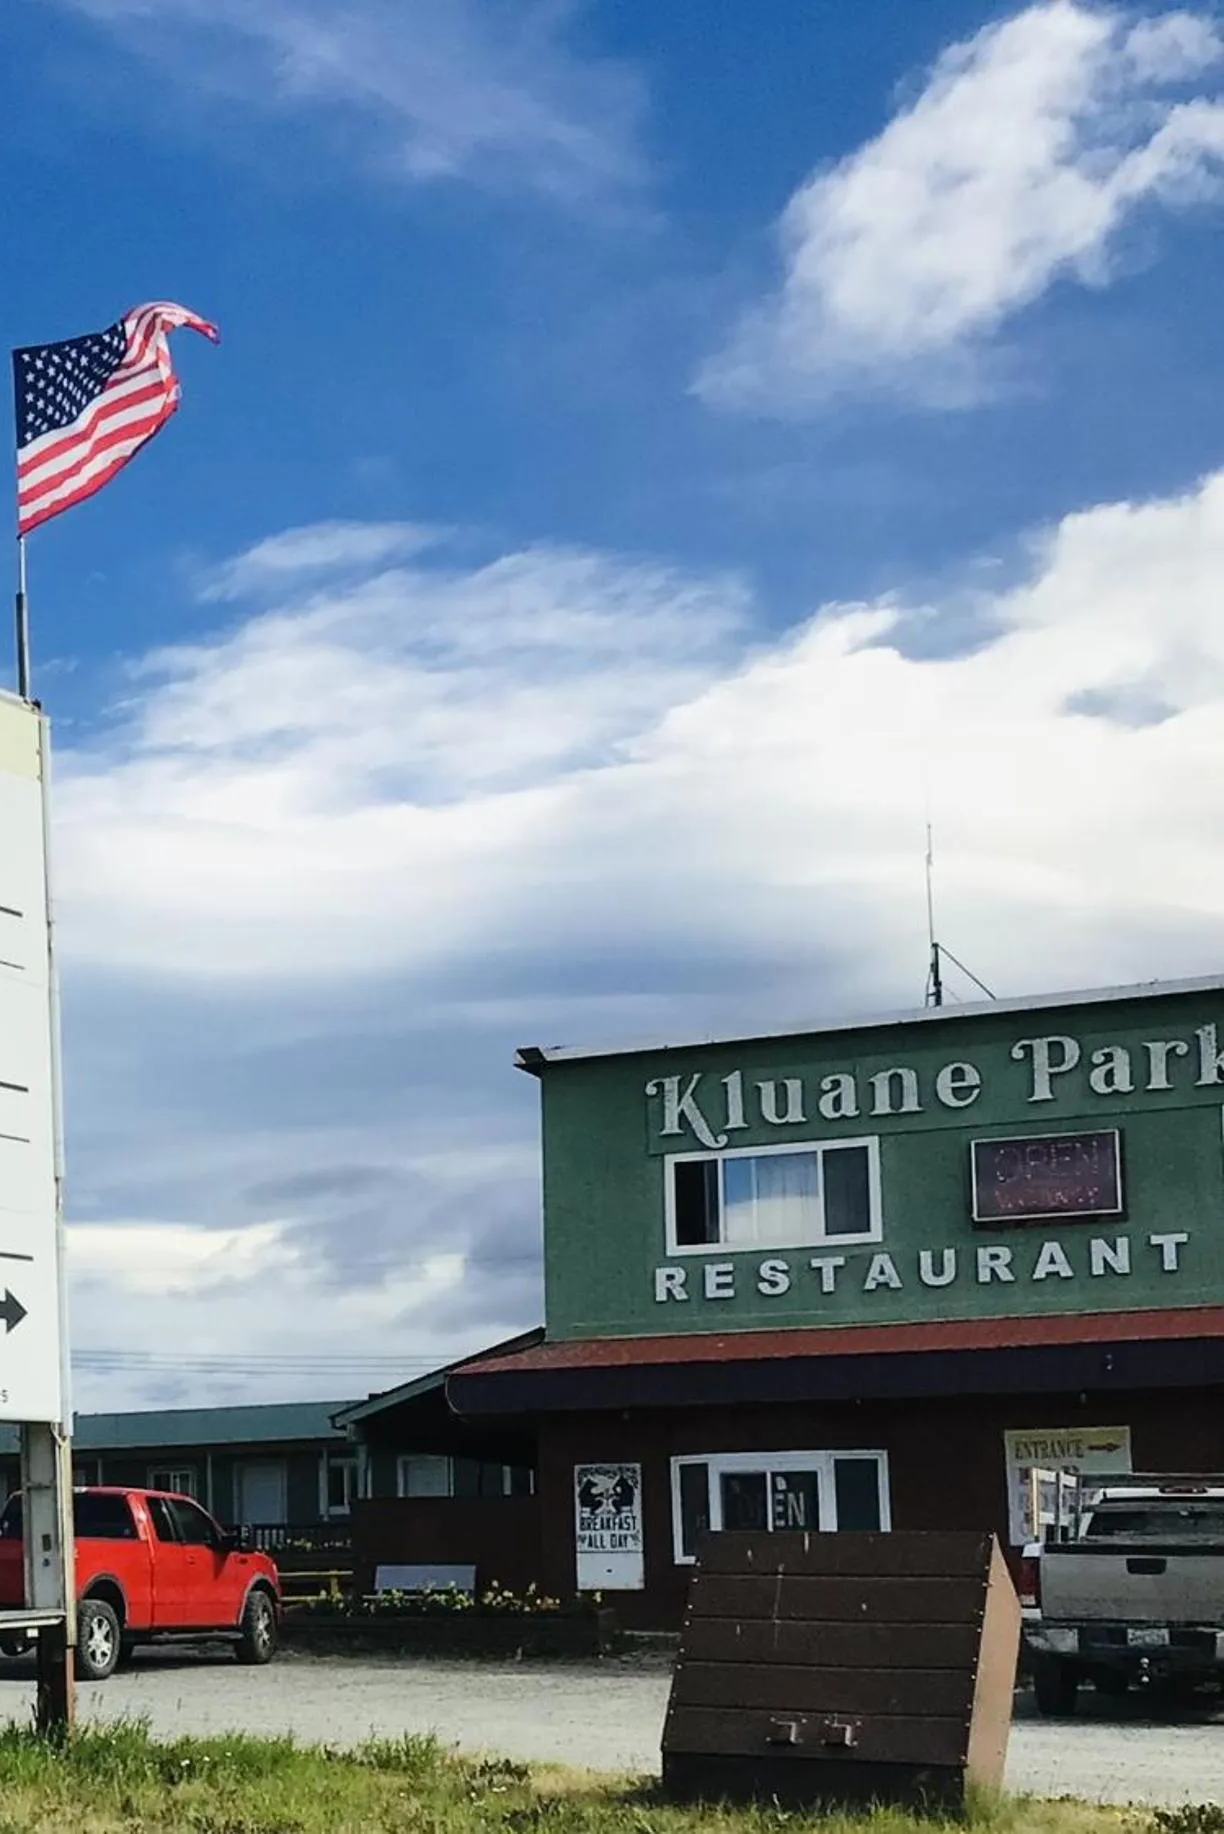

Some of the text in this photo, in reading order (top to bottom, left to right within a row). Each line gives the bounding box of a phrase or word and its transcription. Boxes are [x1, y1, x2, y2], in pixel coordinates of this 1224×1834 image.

[645, 1023, 1224, 1149] Kluane Park
[654, 1232, 1189, 1302] RESTAURANT
[1015, 1439, 1084, 1460] ENTRANCE
[579, 1515, 637, 1532] BREAKFAST
[587, 1533, 629, 1549] ALL DAY
